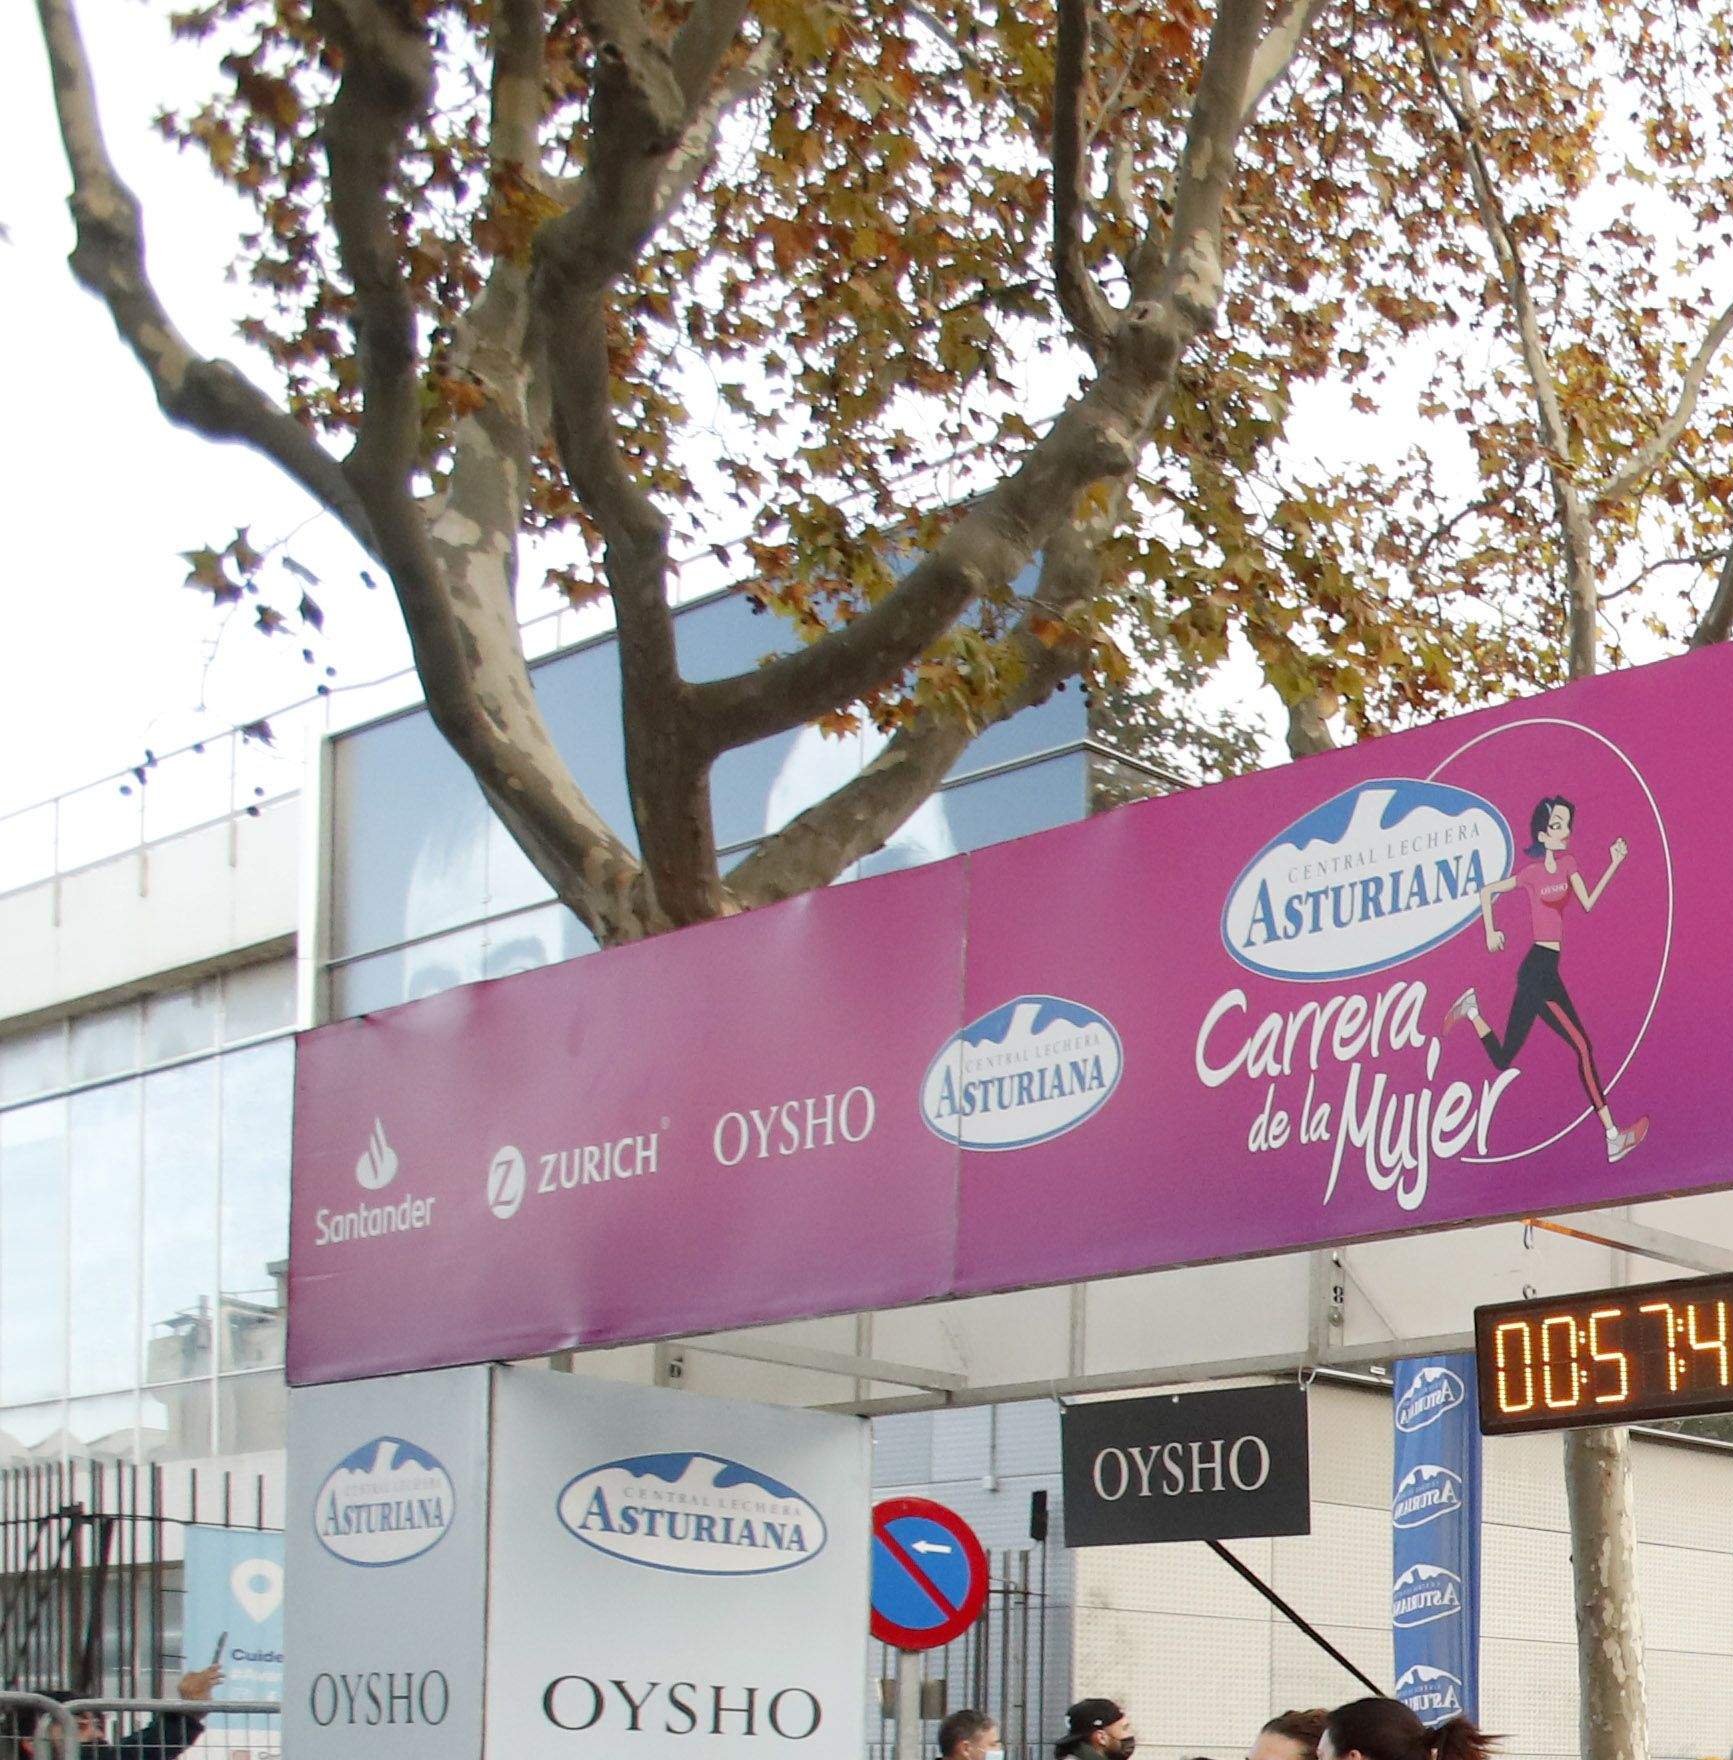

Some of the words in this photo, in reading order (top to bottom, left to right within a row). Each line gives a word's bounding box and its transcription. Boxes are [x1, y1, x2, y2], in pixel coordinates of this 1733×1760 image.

[1287, 847, 1378, 884] CENTRAL
[1387, 823, 1482, 860] LECHERA
[1241, 848, 1488, 949] ASTURIANA
[1196, 980, 1429, 1088] Carrera
[935, 1054, 1108, 1118] ASTURIANA
[712, 1085, 877, 1167] OYSHO
[1247, 1084, 1291, 1152] de
[1300, 1072, 1331, 1146] la
[1323, 1037, 1521, 1211] Mujer
[538, 1134, 660, 1195] ZURICH
[315, 1194, 436, 1246] Santander
[623, 1486, 710, 1511] CENTRAL
[1091, 1433, 1271, 1502] OYSHO
[322, 1490, 445, 1539] ASTURIANA
[577, 1485, 809, 1553] ASTURIANA
[309, 1669, 450, 1728] OYSHO
[542, 1674, 823, 1740] OYSHO
